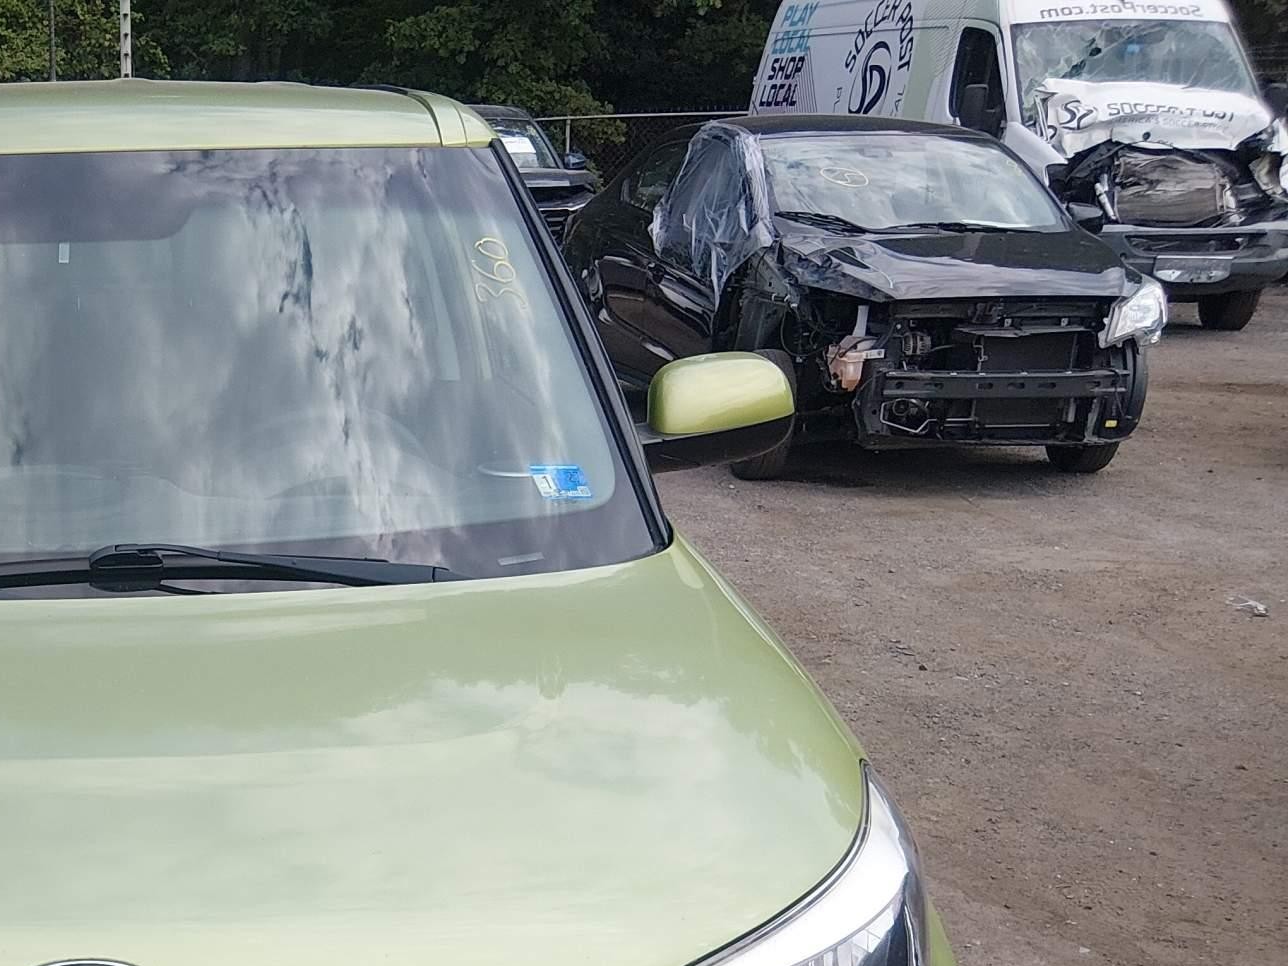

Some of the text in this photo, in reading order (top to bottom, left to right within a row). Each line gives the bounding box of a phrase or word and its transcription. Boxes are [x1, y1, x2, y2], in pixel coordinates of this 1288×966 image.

[781, 1, 819, 27] PLAY
[772, 29, 810, 54] LOCAL
[845, 0, 913, 73] SOCCER POST
[768, 56, 805, 80] SHOP
[759, 84, 797, 107] LOCAL
